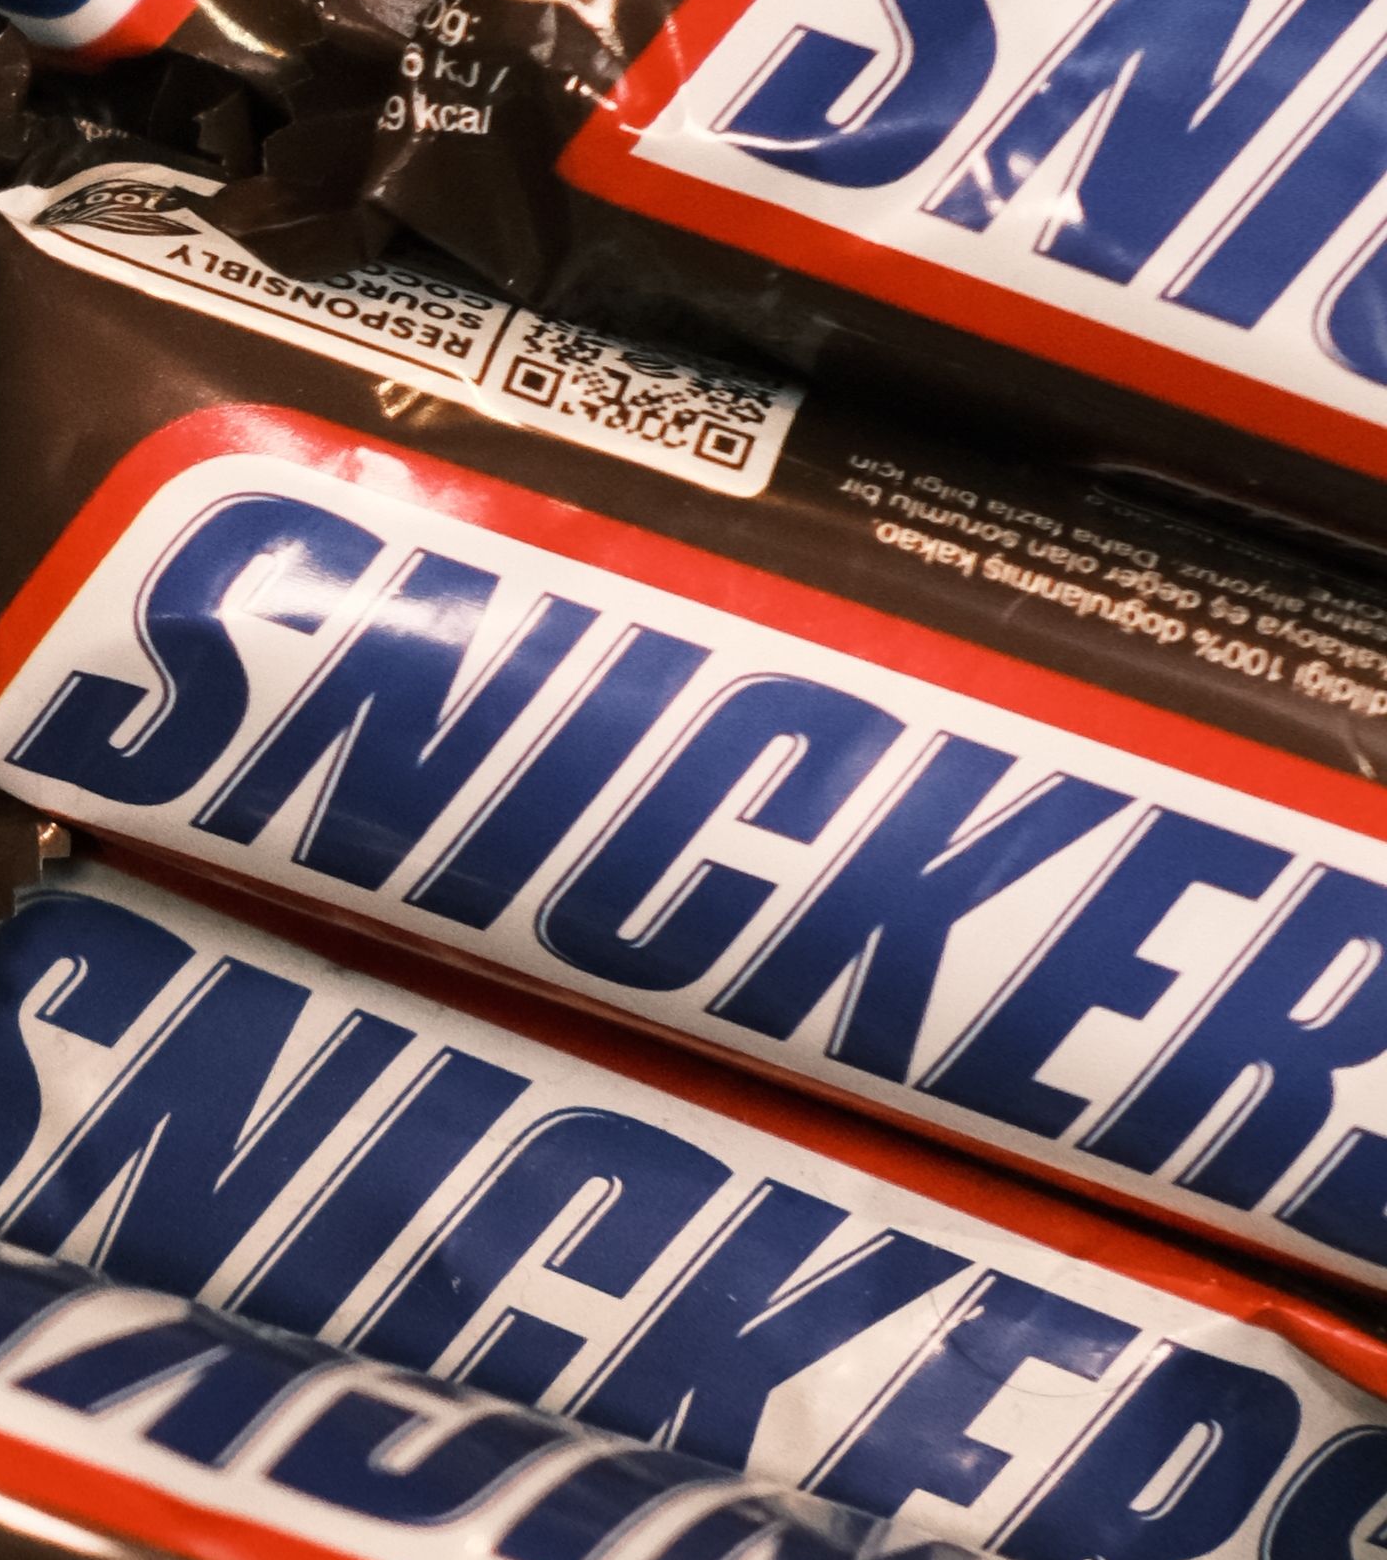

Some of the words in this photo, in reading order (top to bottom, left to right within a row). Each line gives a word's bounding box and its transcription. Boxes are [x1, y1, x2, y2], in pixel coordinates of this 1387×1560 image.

[157, 237, 476, 362] RESPONSIBLY
[839, 478, 883, 507] bir
[889, 493, 1020, 549] sorumlu
[875, 520, 977, 576] kakao.
[1026, 539, 1099, 575] olan
[1071, 527, 1159, 571] Daha
[983, 554, 1186, 643] doğrulanmış
[1103, 562, 1201, 609] değer
[1192, 629, 1283, 682] 100%
